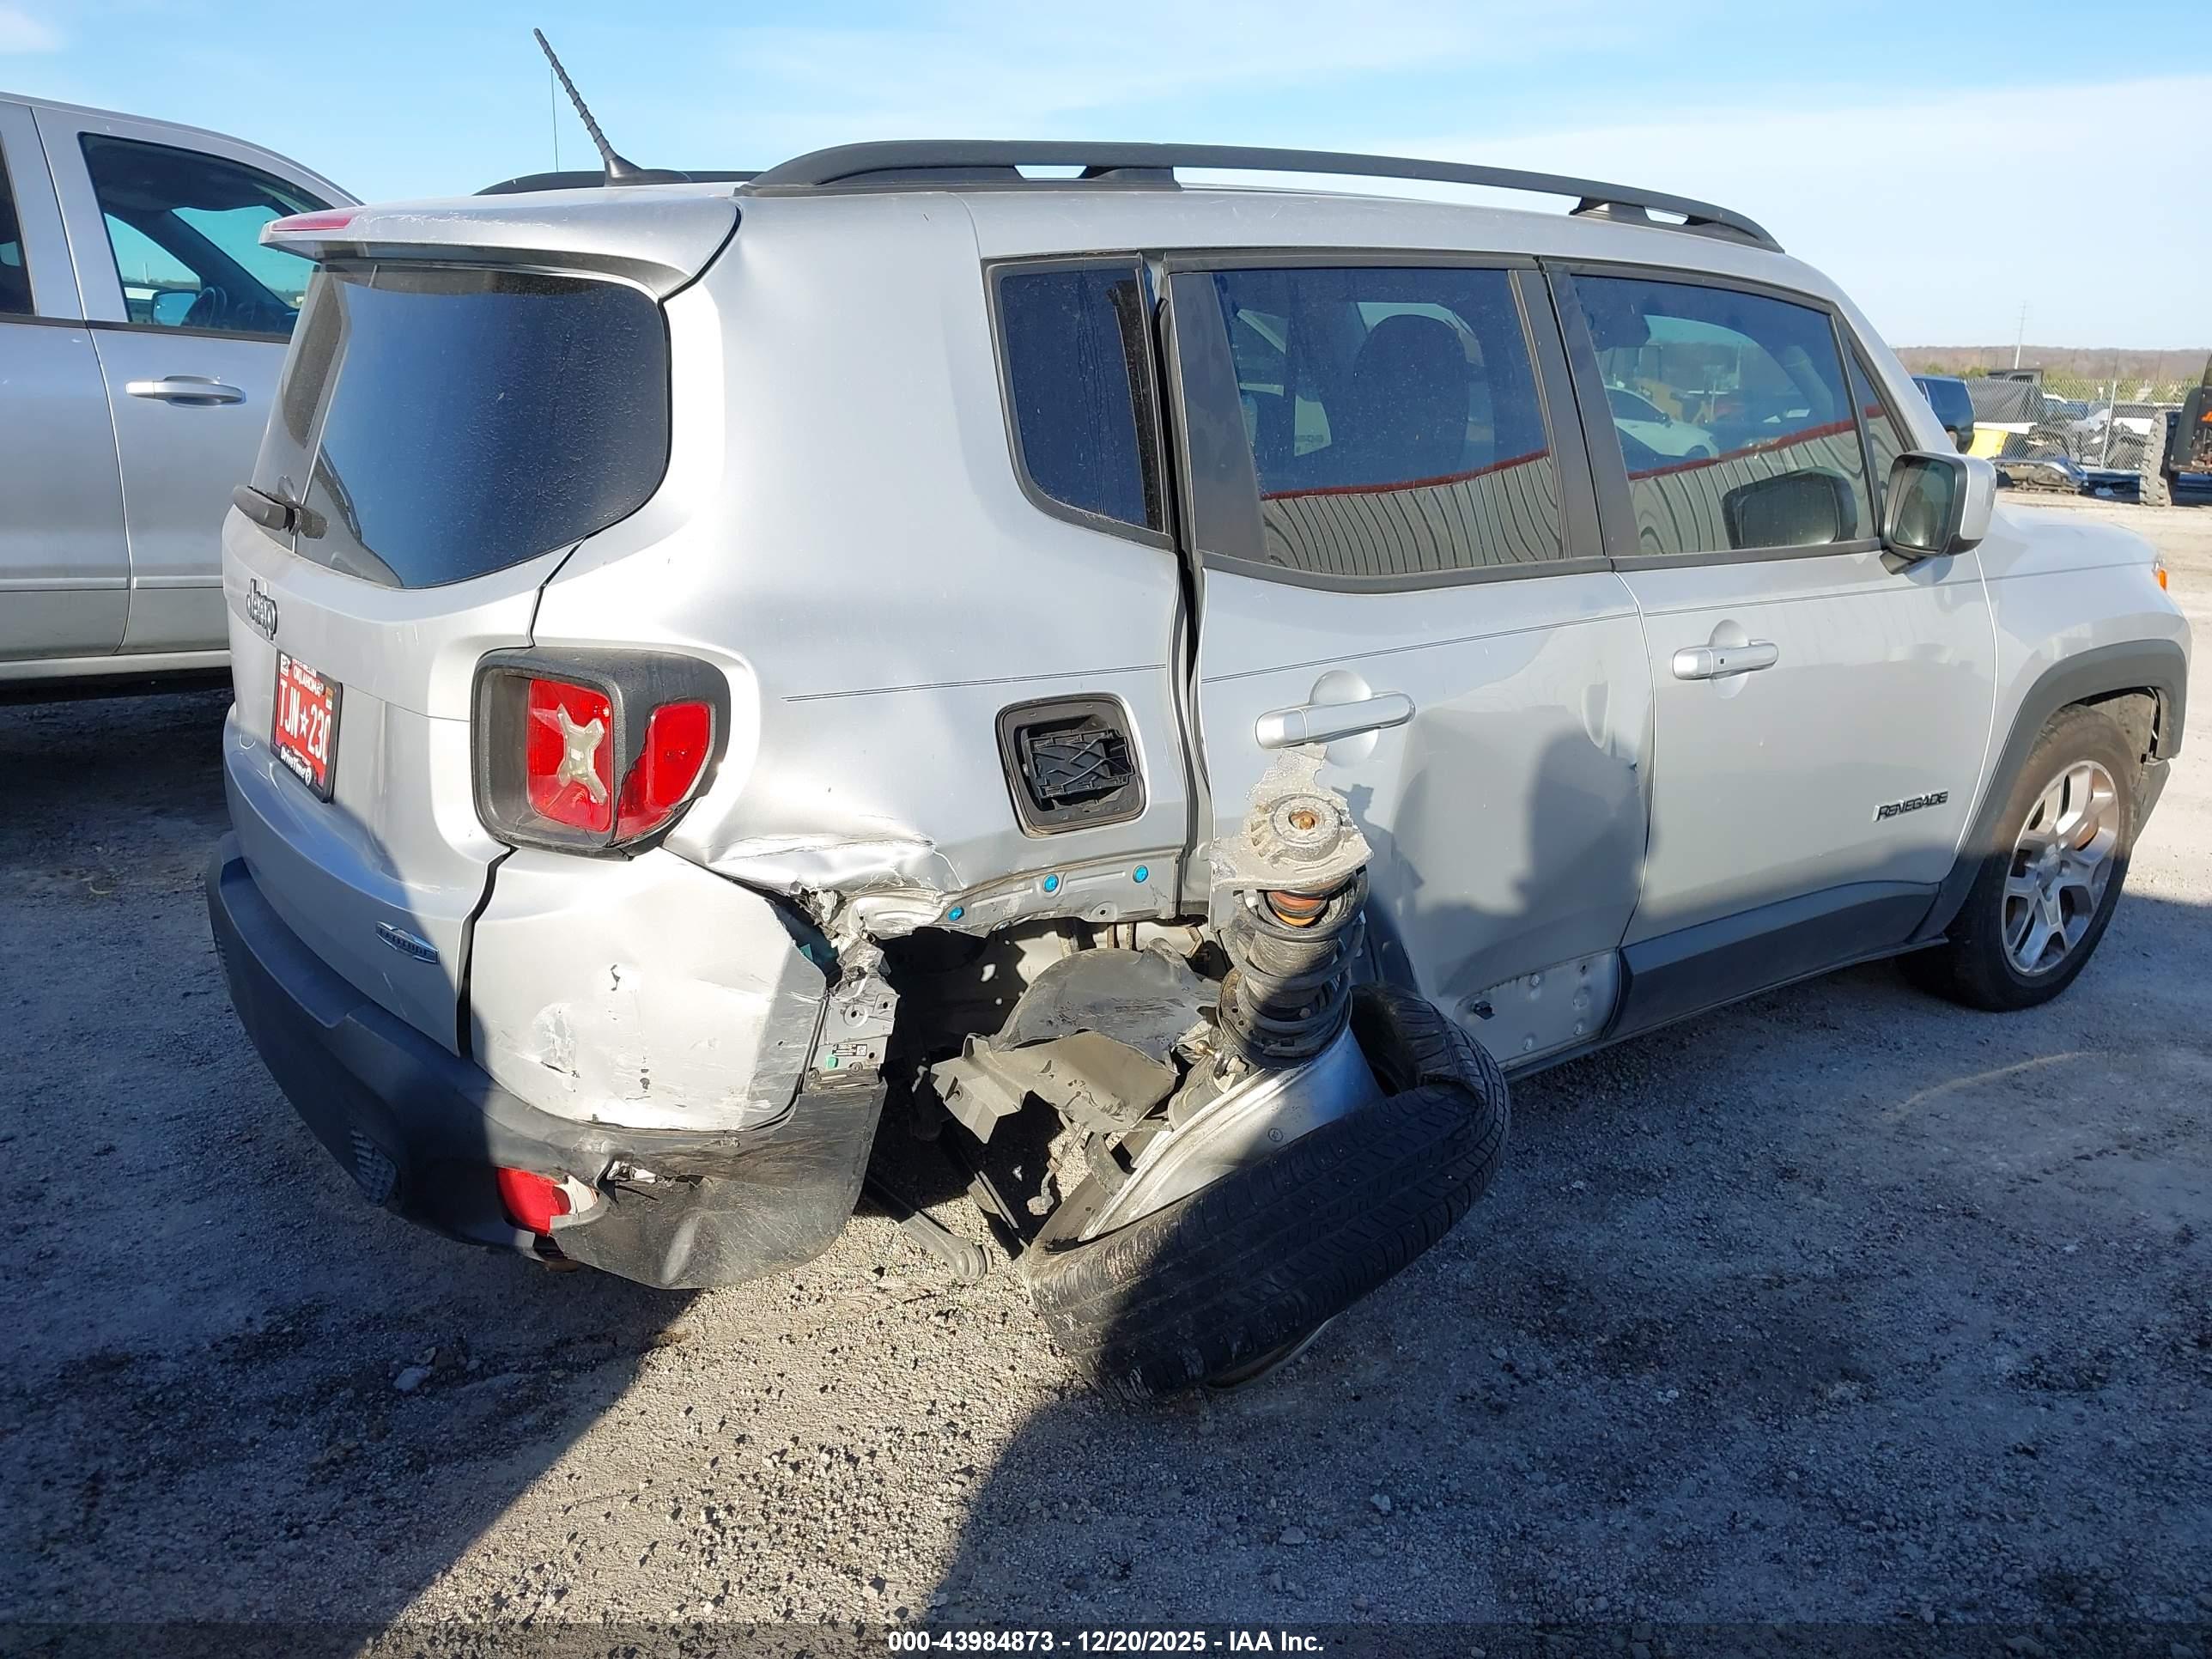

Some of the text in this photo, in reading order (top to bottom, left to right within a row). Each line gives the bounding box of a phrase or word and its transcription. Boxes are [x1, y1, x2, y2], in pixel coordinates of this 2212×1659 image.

[246, 578, 278, 641] Jeep
[279, 678, 301, 739] TJN
[1874, 791, 1948, 822] RENEGADE
